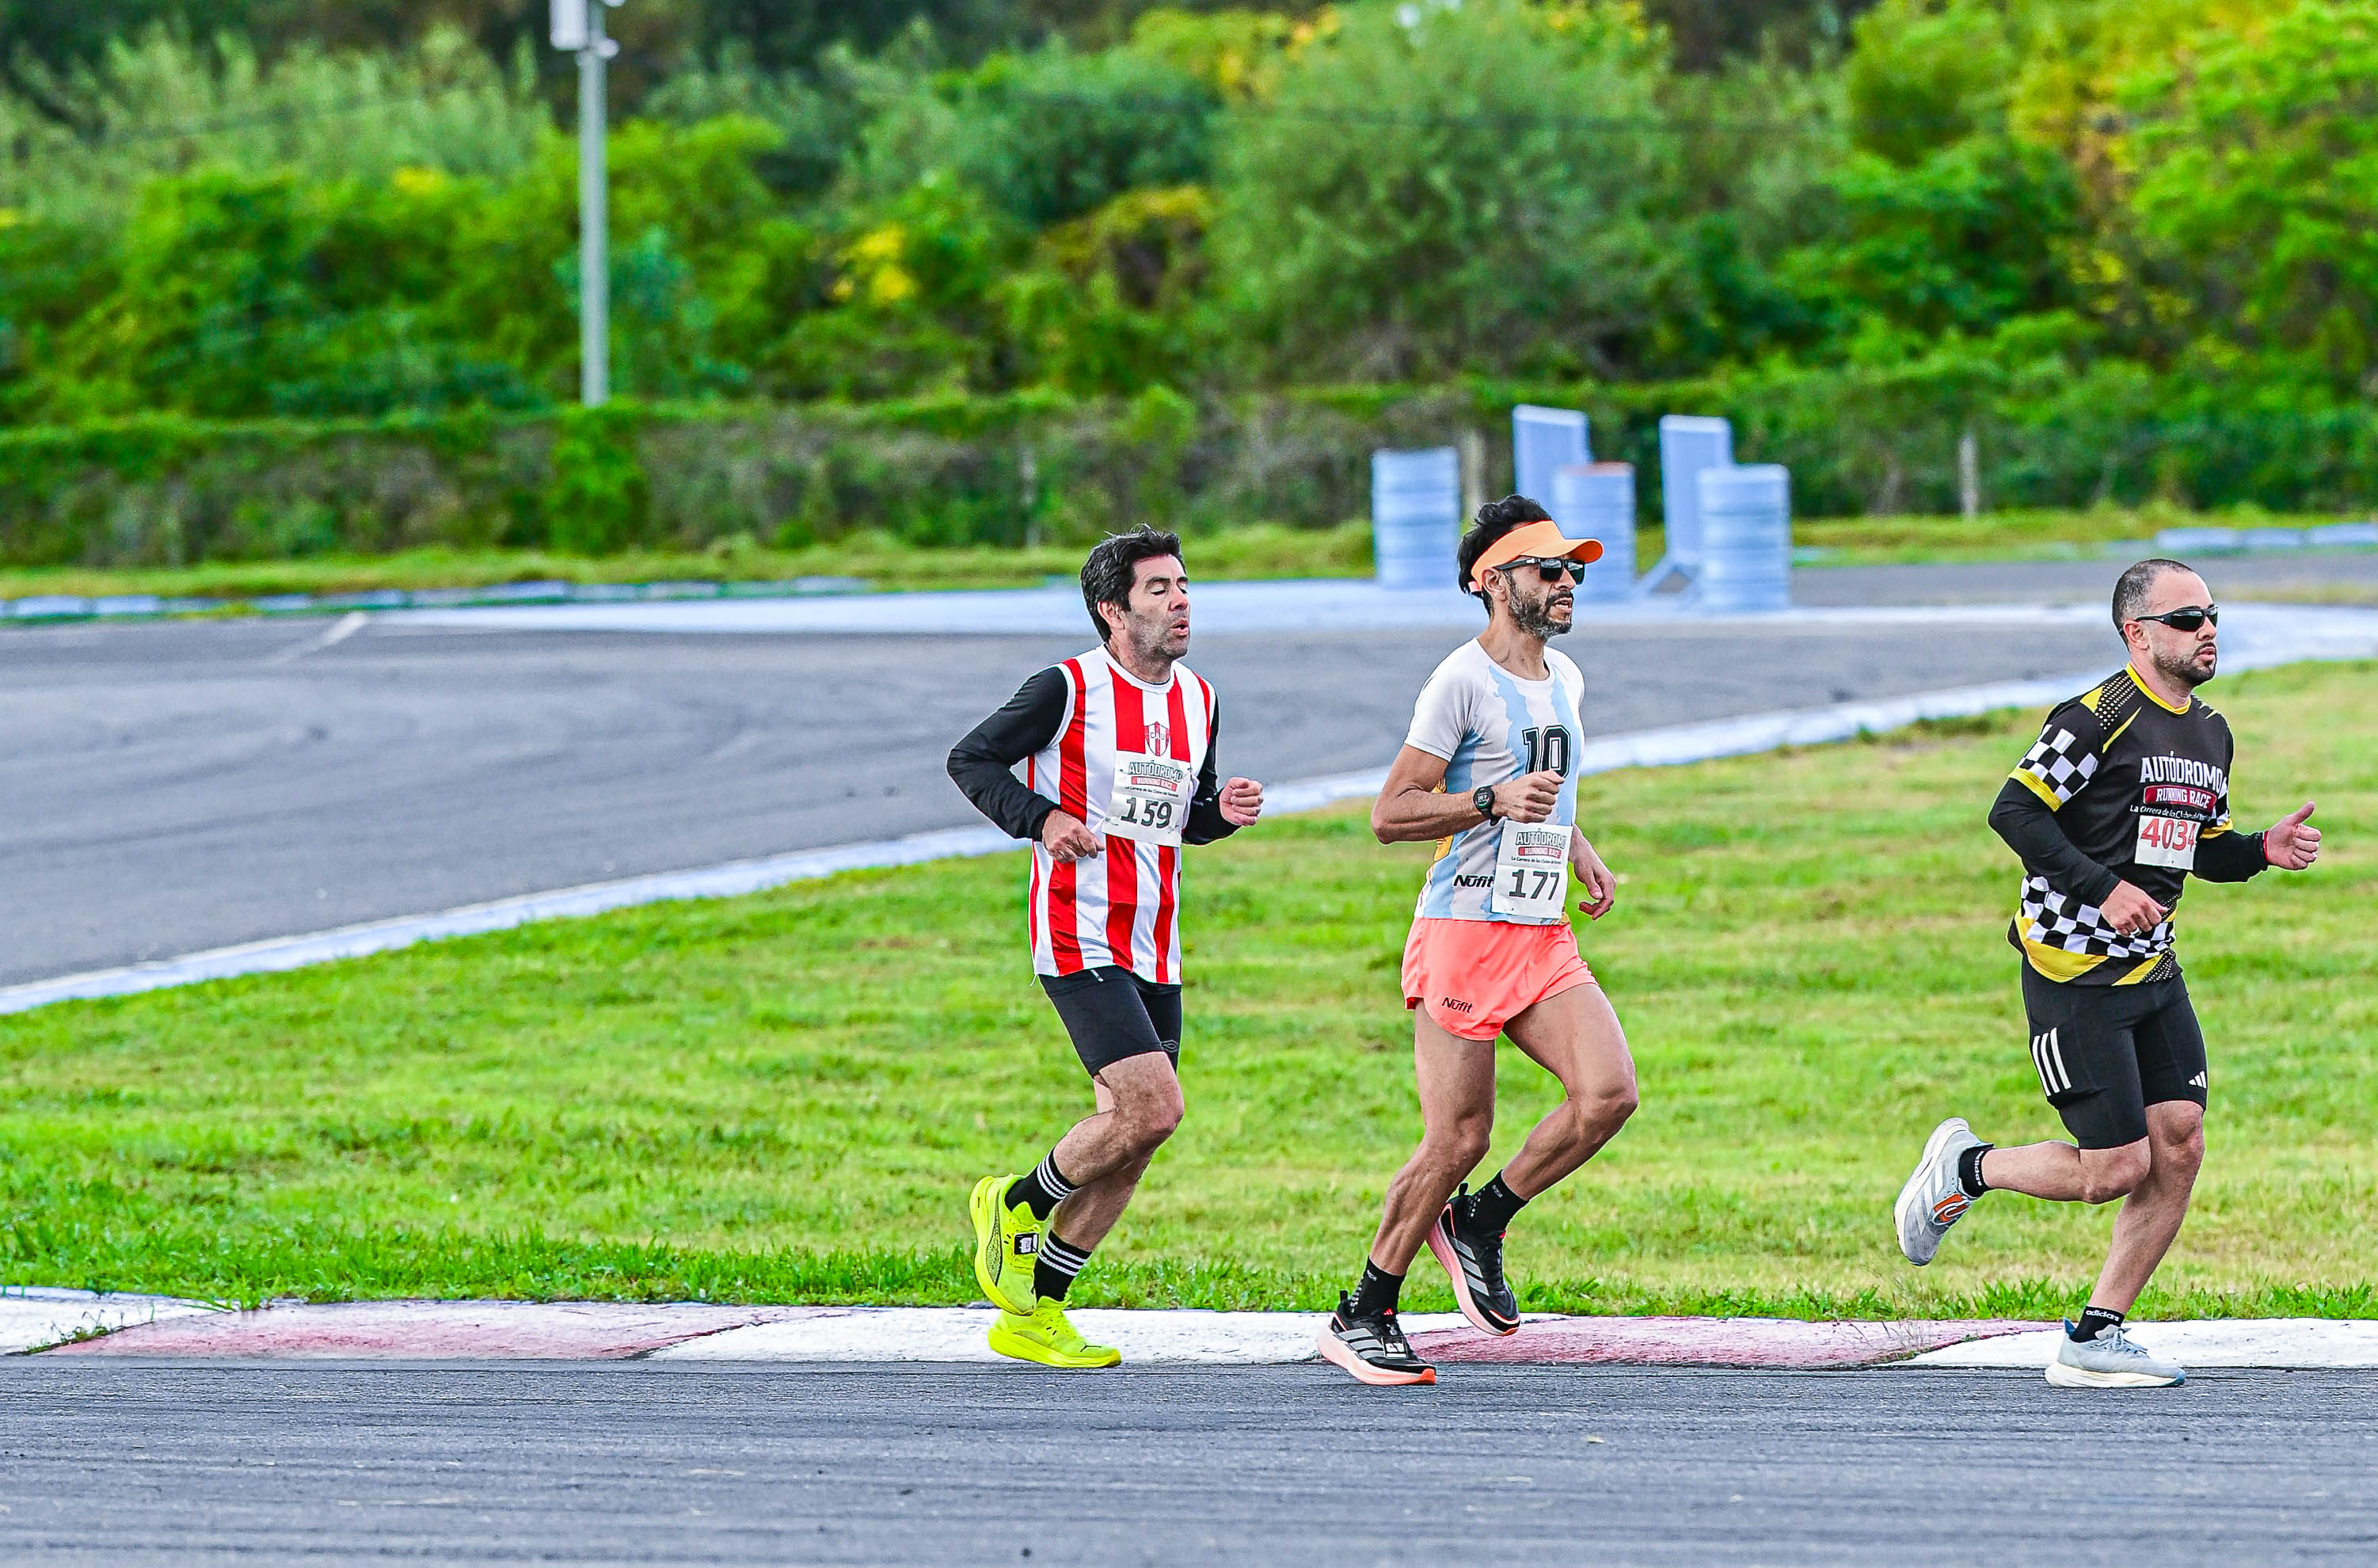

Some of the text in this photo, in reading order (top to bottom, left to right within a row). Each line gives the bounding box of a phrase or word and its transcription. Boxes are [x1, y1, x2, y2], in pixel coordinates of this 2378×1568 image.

[1522, 725, 1570, 779] 10
[1128, 759, 1183, 783] AUTÓDROMO
[2140, 750, 2224, 794] AUTÓDROMO
[1121, 797, 1173, 828] 159
[2155, 788, 2212, 809] RUNNING RACE
[1515, 828, 1566, 849] AUTÓDROM
[2140, 818, 2198, 852] 4034
[1509, 869, 1560, 900] 177
